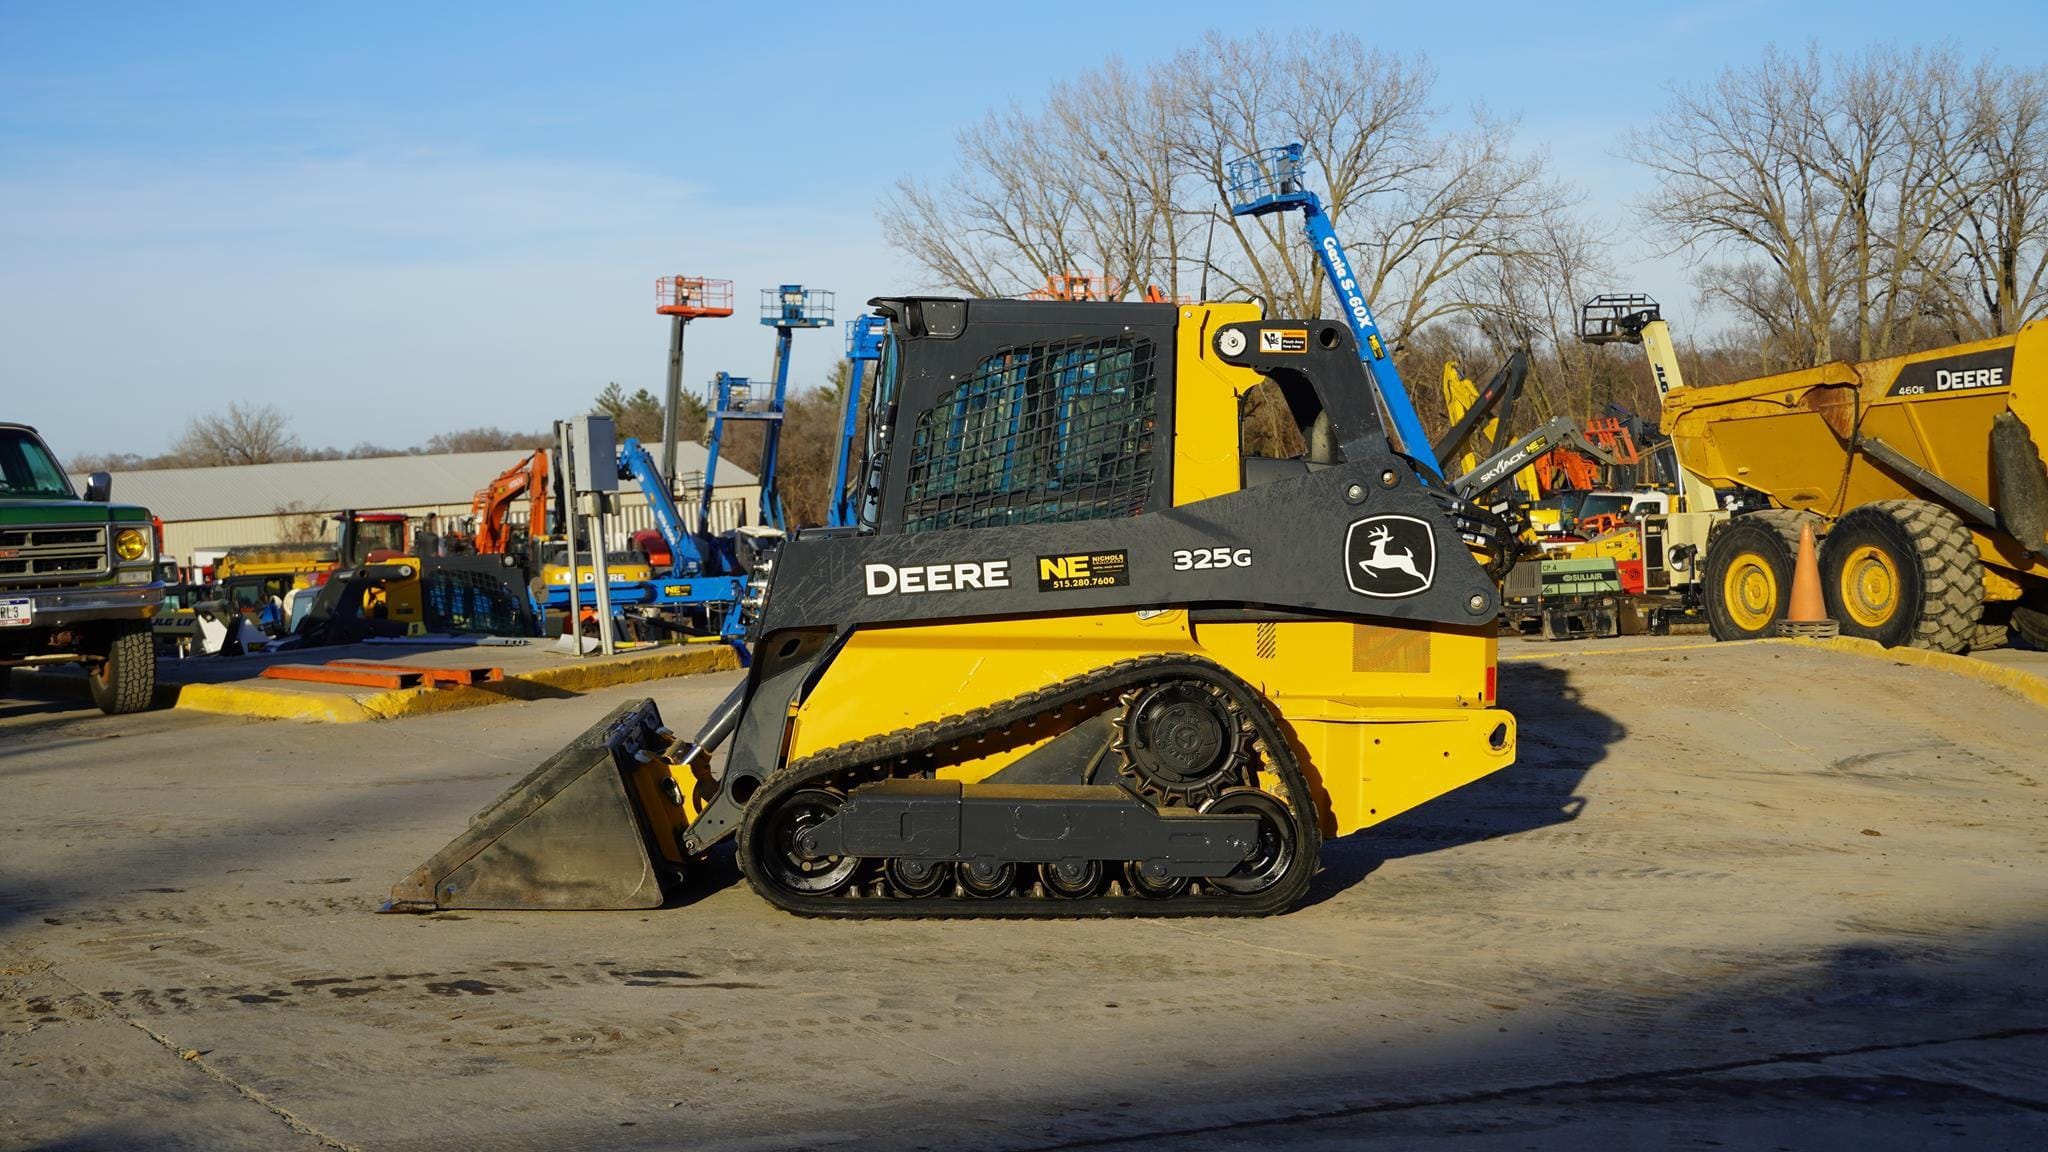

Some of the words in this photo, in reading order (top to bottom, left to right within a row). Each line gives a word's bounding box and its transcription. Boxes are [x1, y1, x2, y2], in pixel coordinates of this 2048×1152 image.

[1323, 236, 1347, 279] Genie
[1340, 278, 1374, 329] S-60X
[1654, 363, 1670, 393] JLG
[1936, 367, 2003, 391] DEERE
[1898, 385, 1925, 396] 460E
[1480, 450, 1527, 483] SKYJACK
[1040, 555, 1091, 580] NE
[1173, 547, 1252, 571] 325G
[865, 560, 1010, 596] DEERE
[1053, 576, 1115, 589] 515.280.7600
[1572, 572, 1604, 581] SULLAIR
